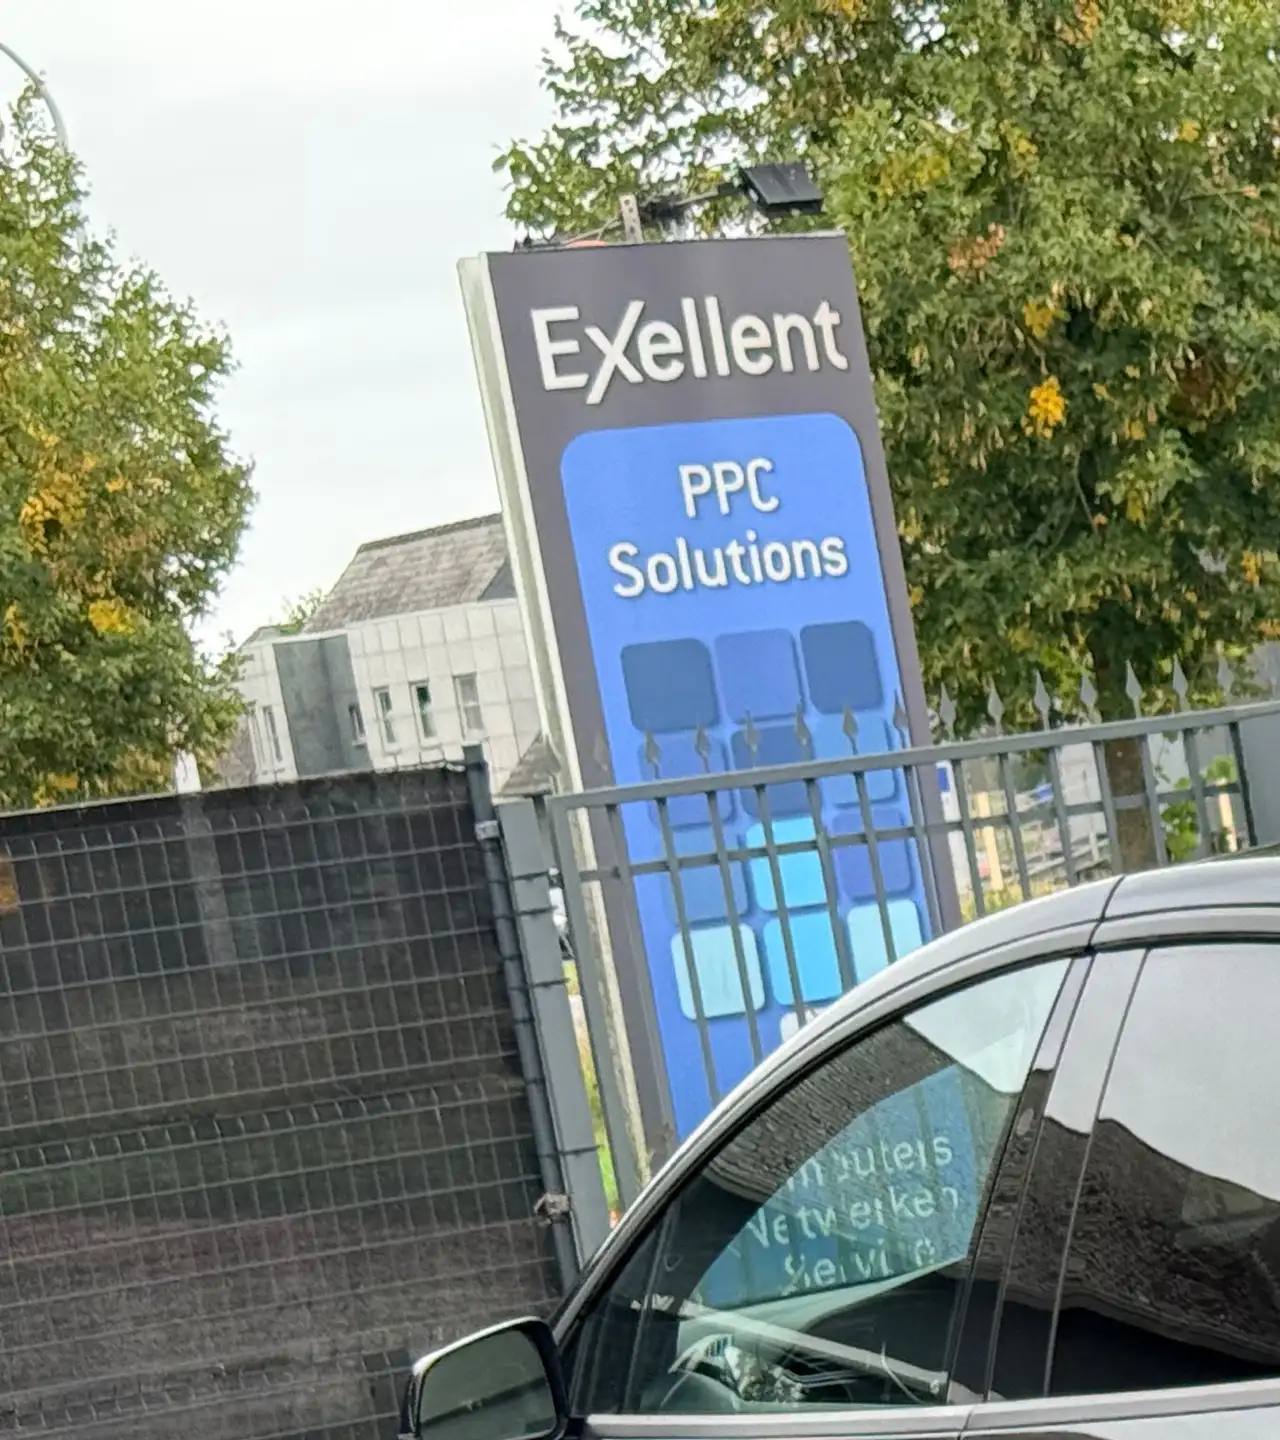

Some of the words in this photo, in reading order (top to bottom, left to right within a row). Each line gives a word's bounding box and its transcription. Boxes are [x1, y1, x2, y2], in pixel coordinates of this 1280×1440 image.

[530, 296, 849, 405] Exellent
[678, 457, 780, 519] PPC
[608, 529, 849, 598] Solutions
